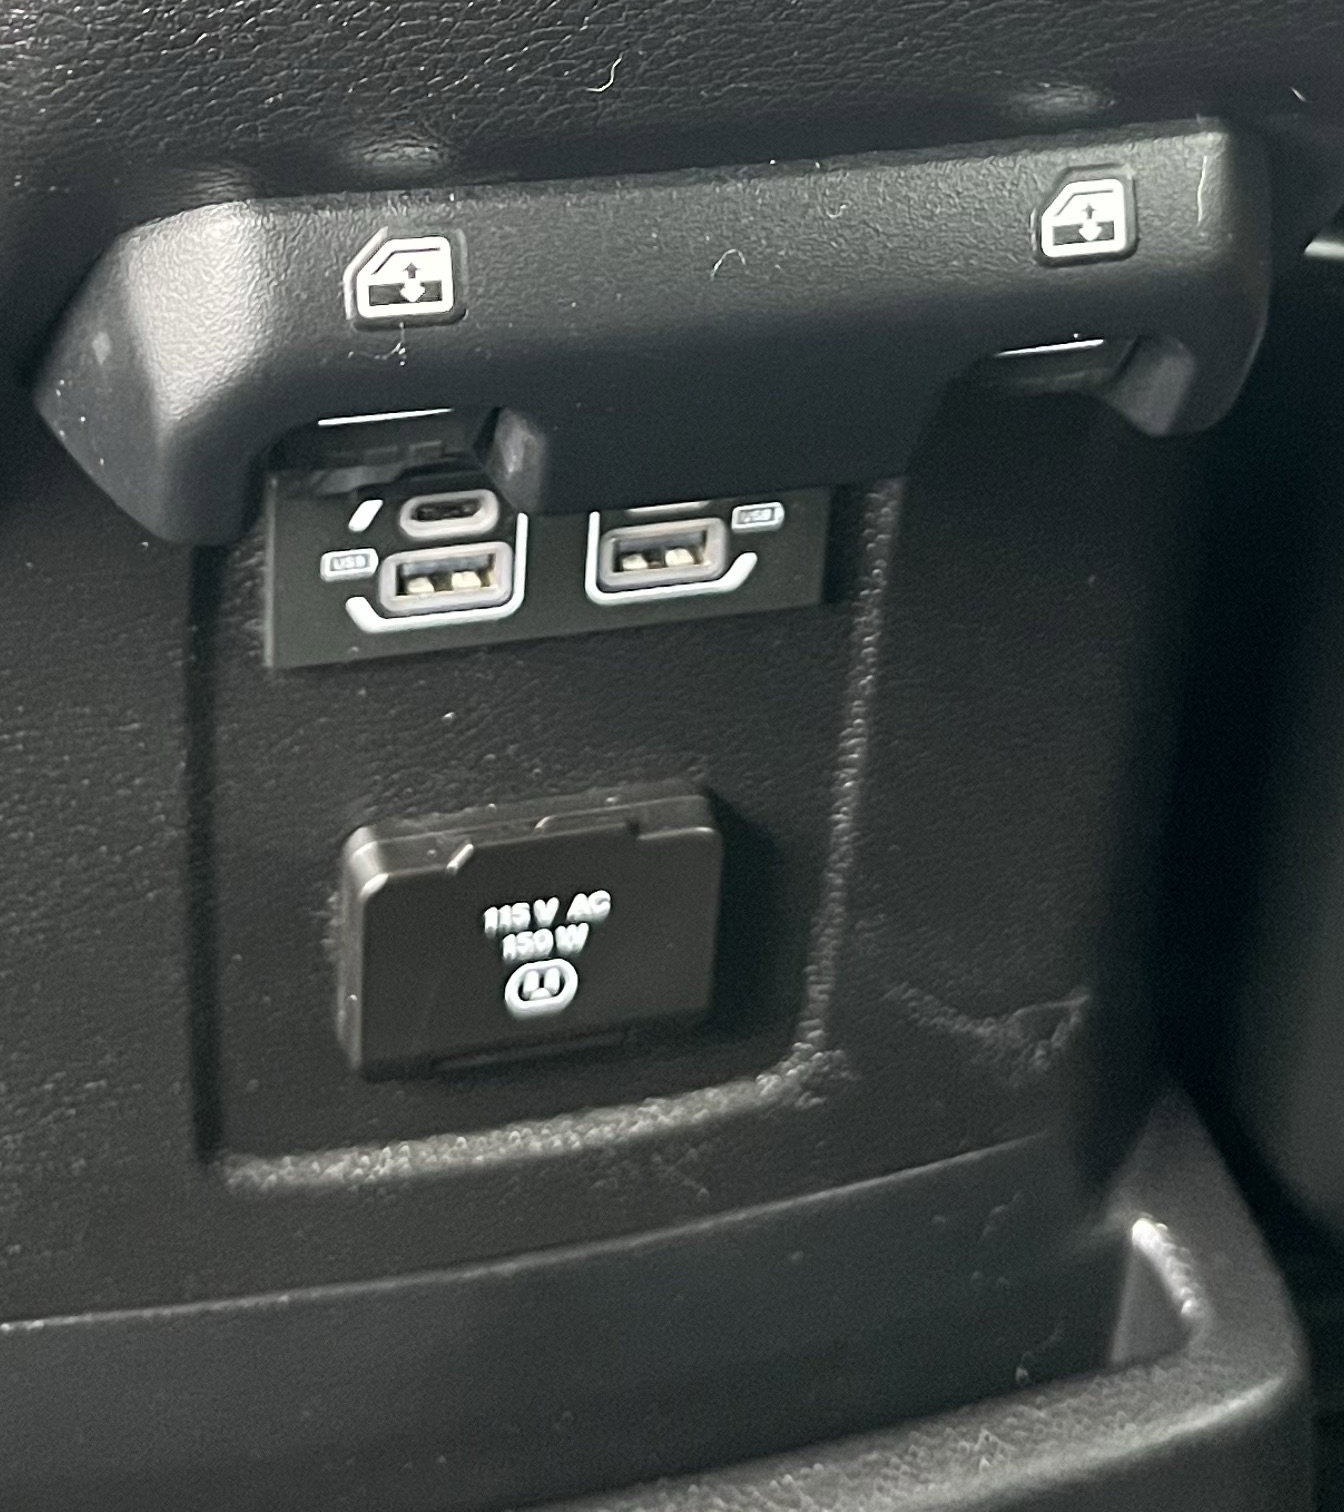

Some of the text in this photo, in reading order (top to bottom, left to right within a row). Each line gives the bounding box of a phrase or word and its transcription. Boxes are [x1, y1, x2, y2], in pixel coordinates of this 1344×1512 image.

[332, 555, 366, 571] USB
[484, 902, 531, 936] 115
[533, 897, 559, 926] V
[503, 922, 589, 963] 150 W
